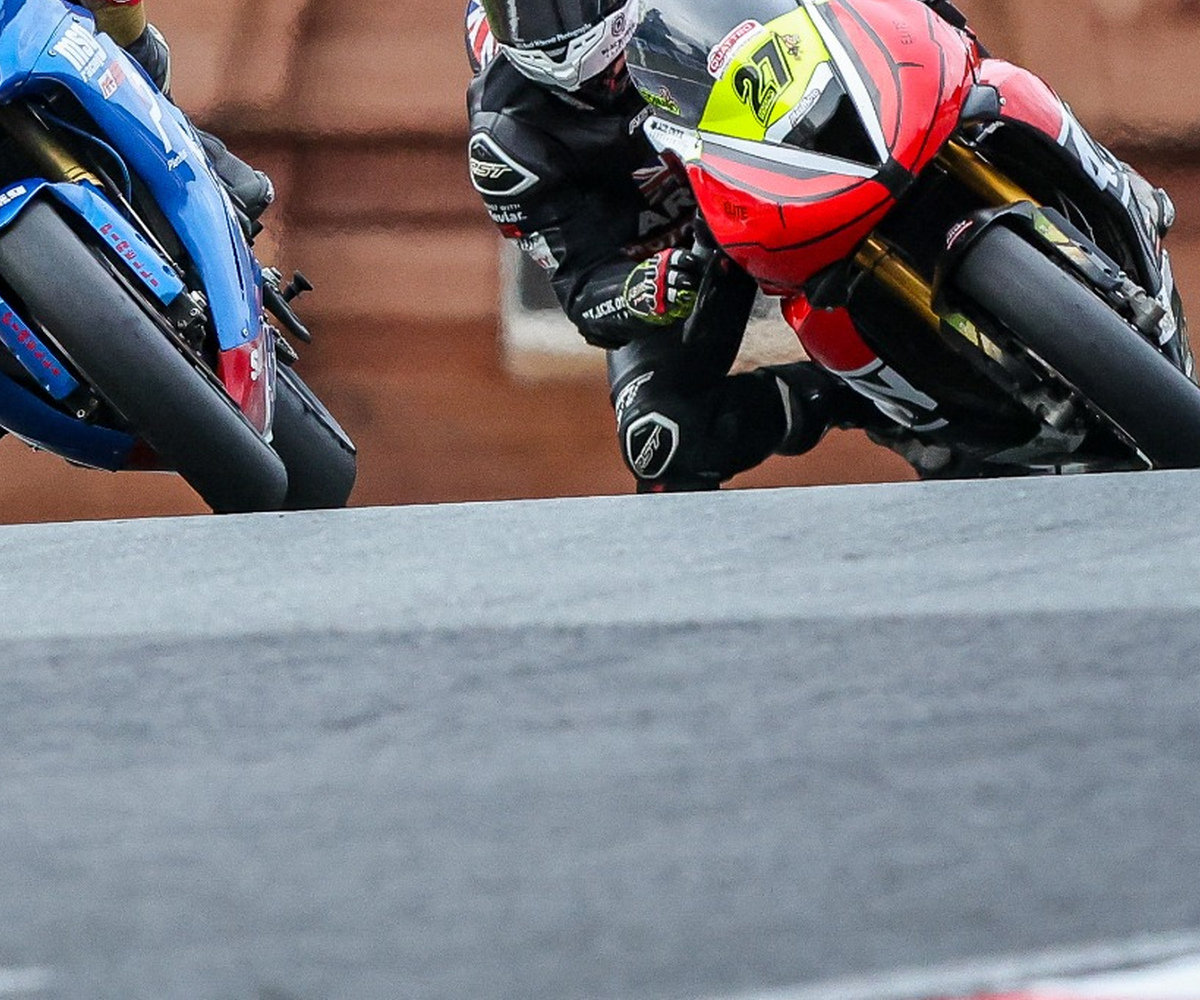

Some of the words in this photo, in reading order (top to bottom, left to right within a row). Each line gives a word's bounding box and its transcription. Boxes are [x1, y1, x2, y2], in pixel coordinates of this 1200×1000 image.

[709, 22, 754, 72] QUATTRO
[732, 35, 793, 126] 27
[470, 160, 513, 179] RST
[634, 424, 664, 474] RST
